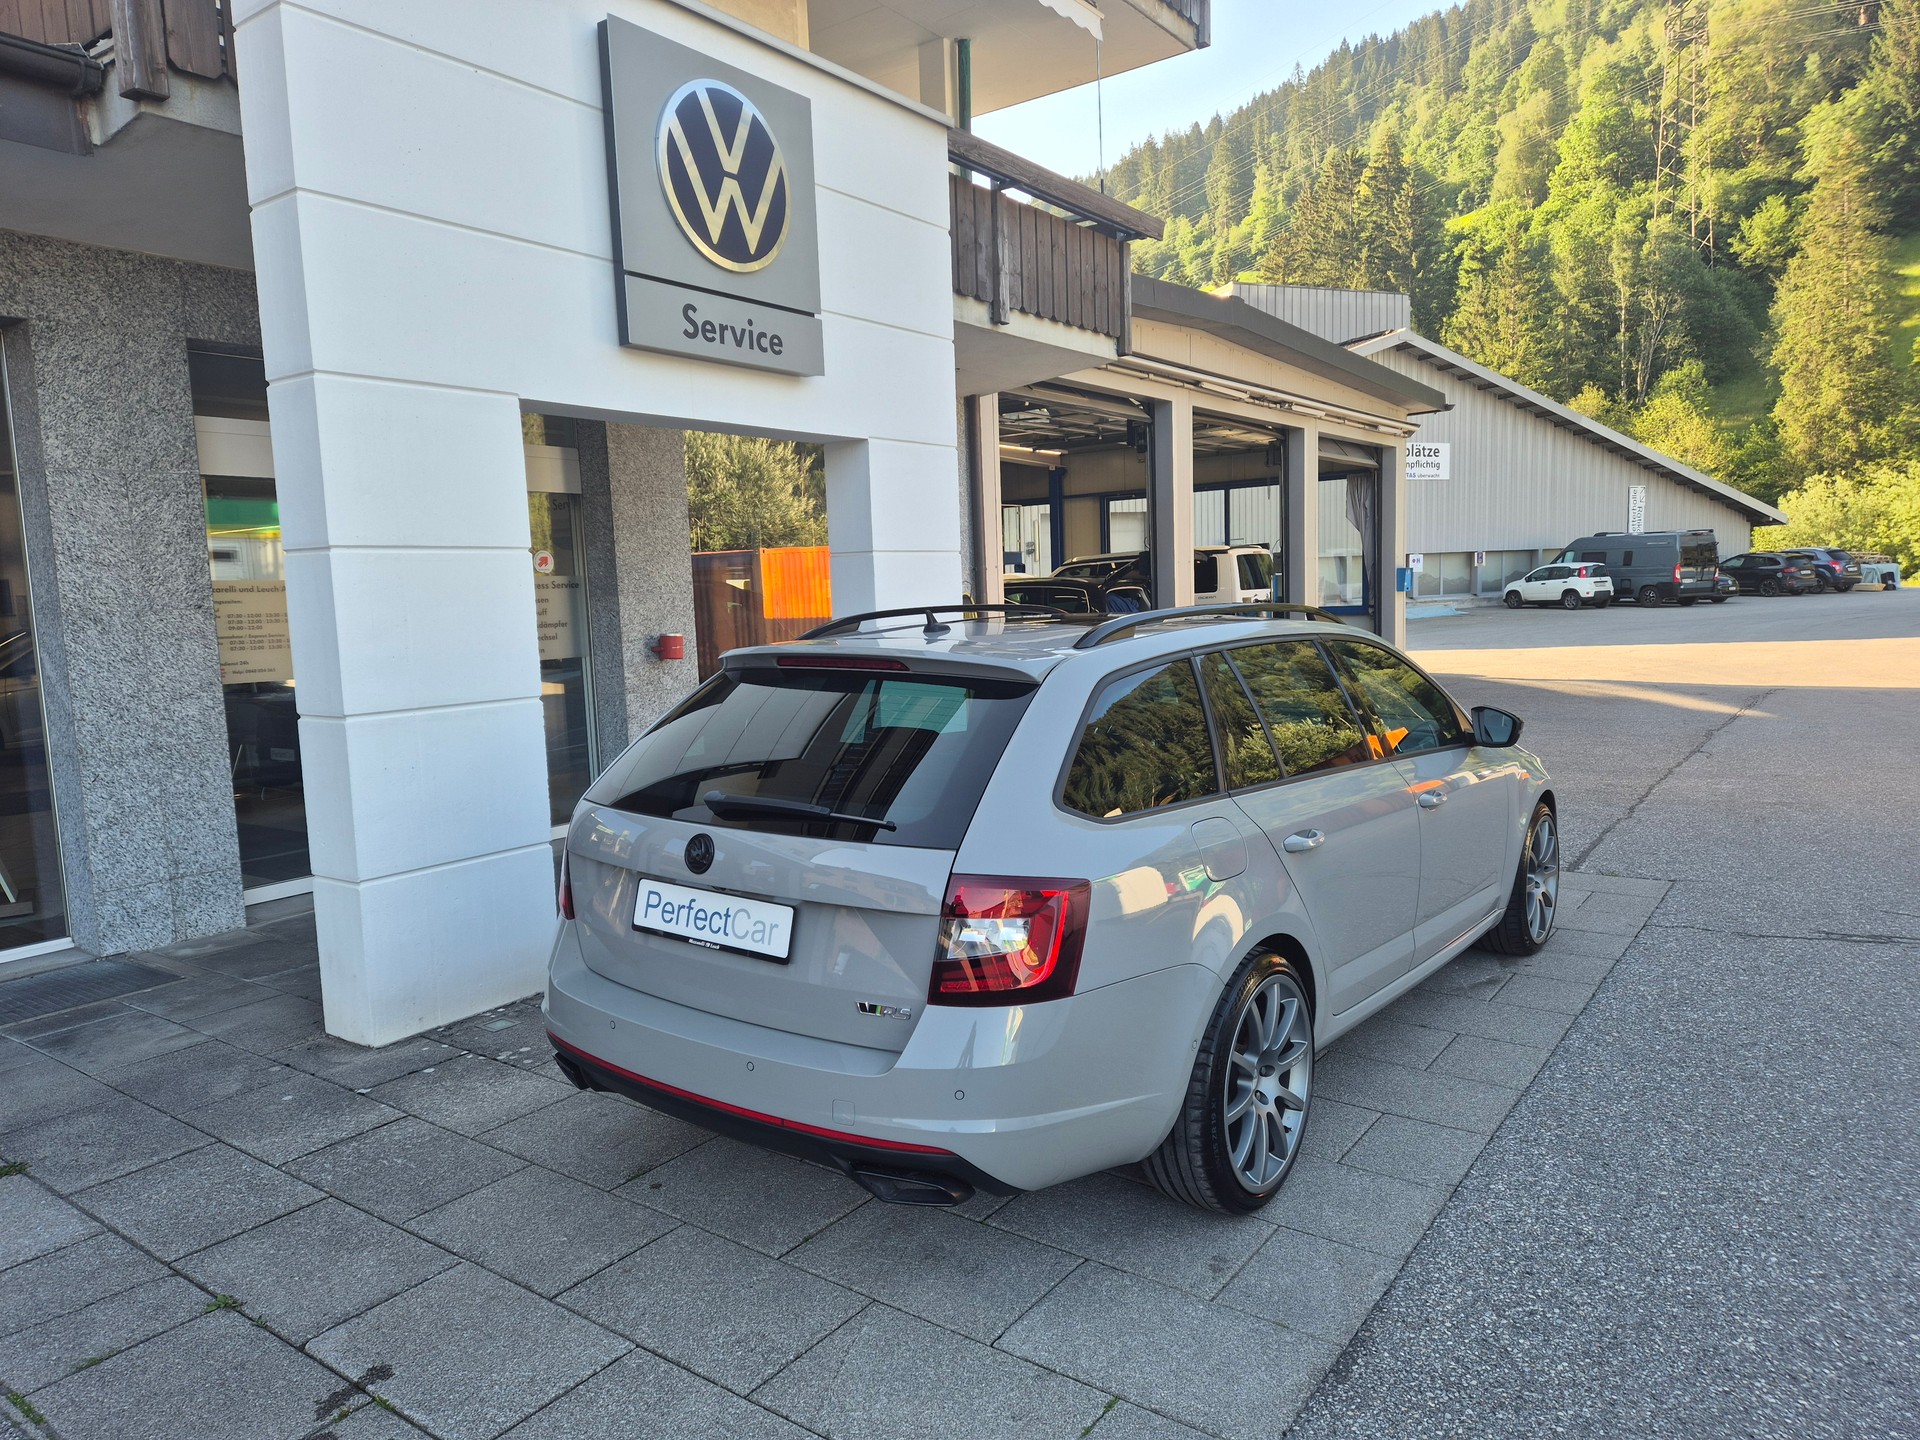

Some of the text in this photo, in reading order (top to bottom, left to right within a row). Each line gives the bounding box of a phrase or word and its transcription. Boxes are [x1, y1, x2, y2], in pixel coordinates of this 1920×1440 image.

[682, 303, 783, 356] Service
[551, 581, 579, 589] Service
[644, 890, 779, 946] PerfectCar
